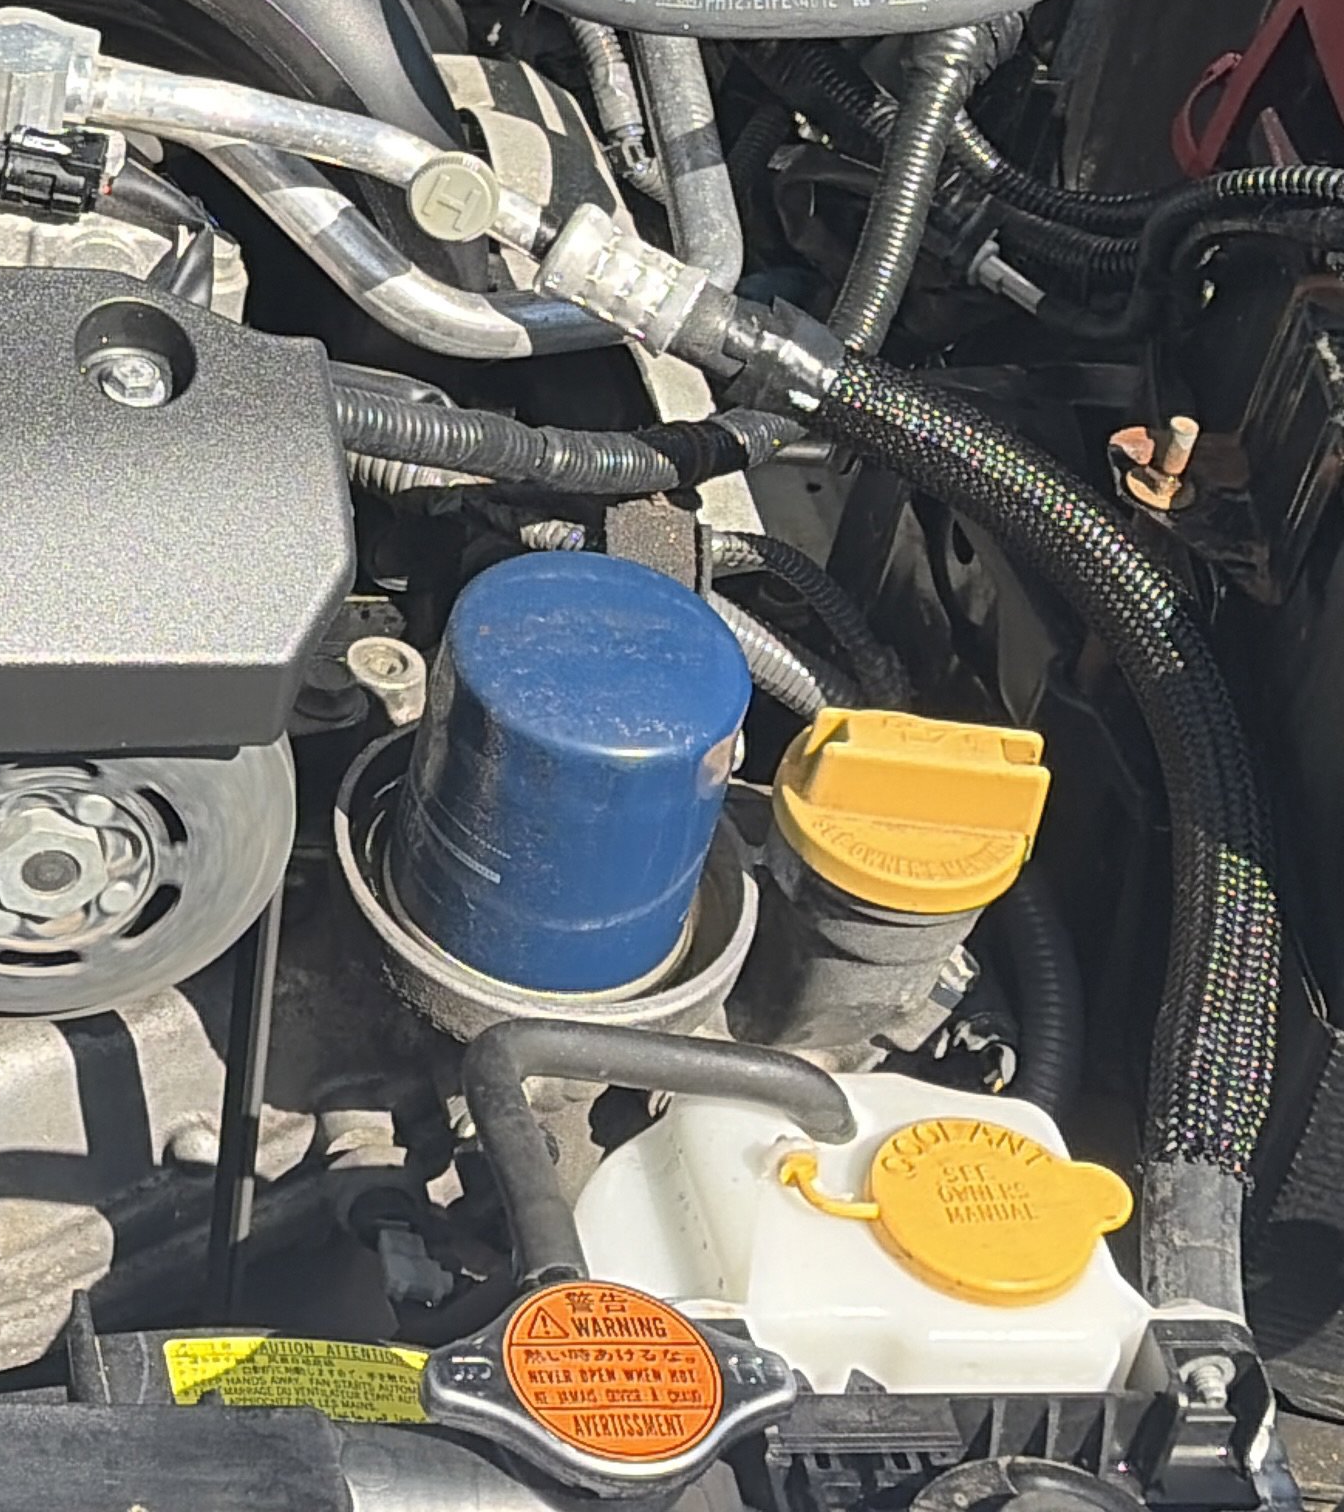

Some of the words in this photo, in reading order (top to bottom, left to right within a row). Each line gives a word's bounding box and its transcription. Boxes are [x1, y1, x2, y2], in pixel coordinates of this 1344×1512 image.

[945, 1203, 1041, 1225] MANUAL
[564, 1290, 629, 1314] 警告
[570, 1316, 668, 1339] WARNING
